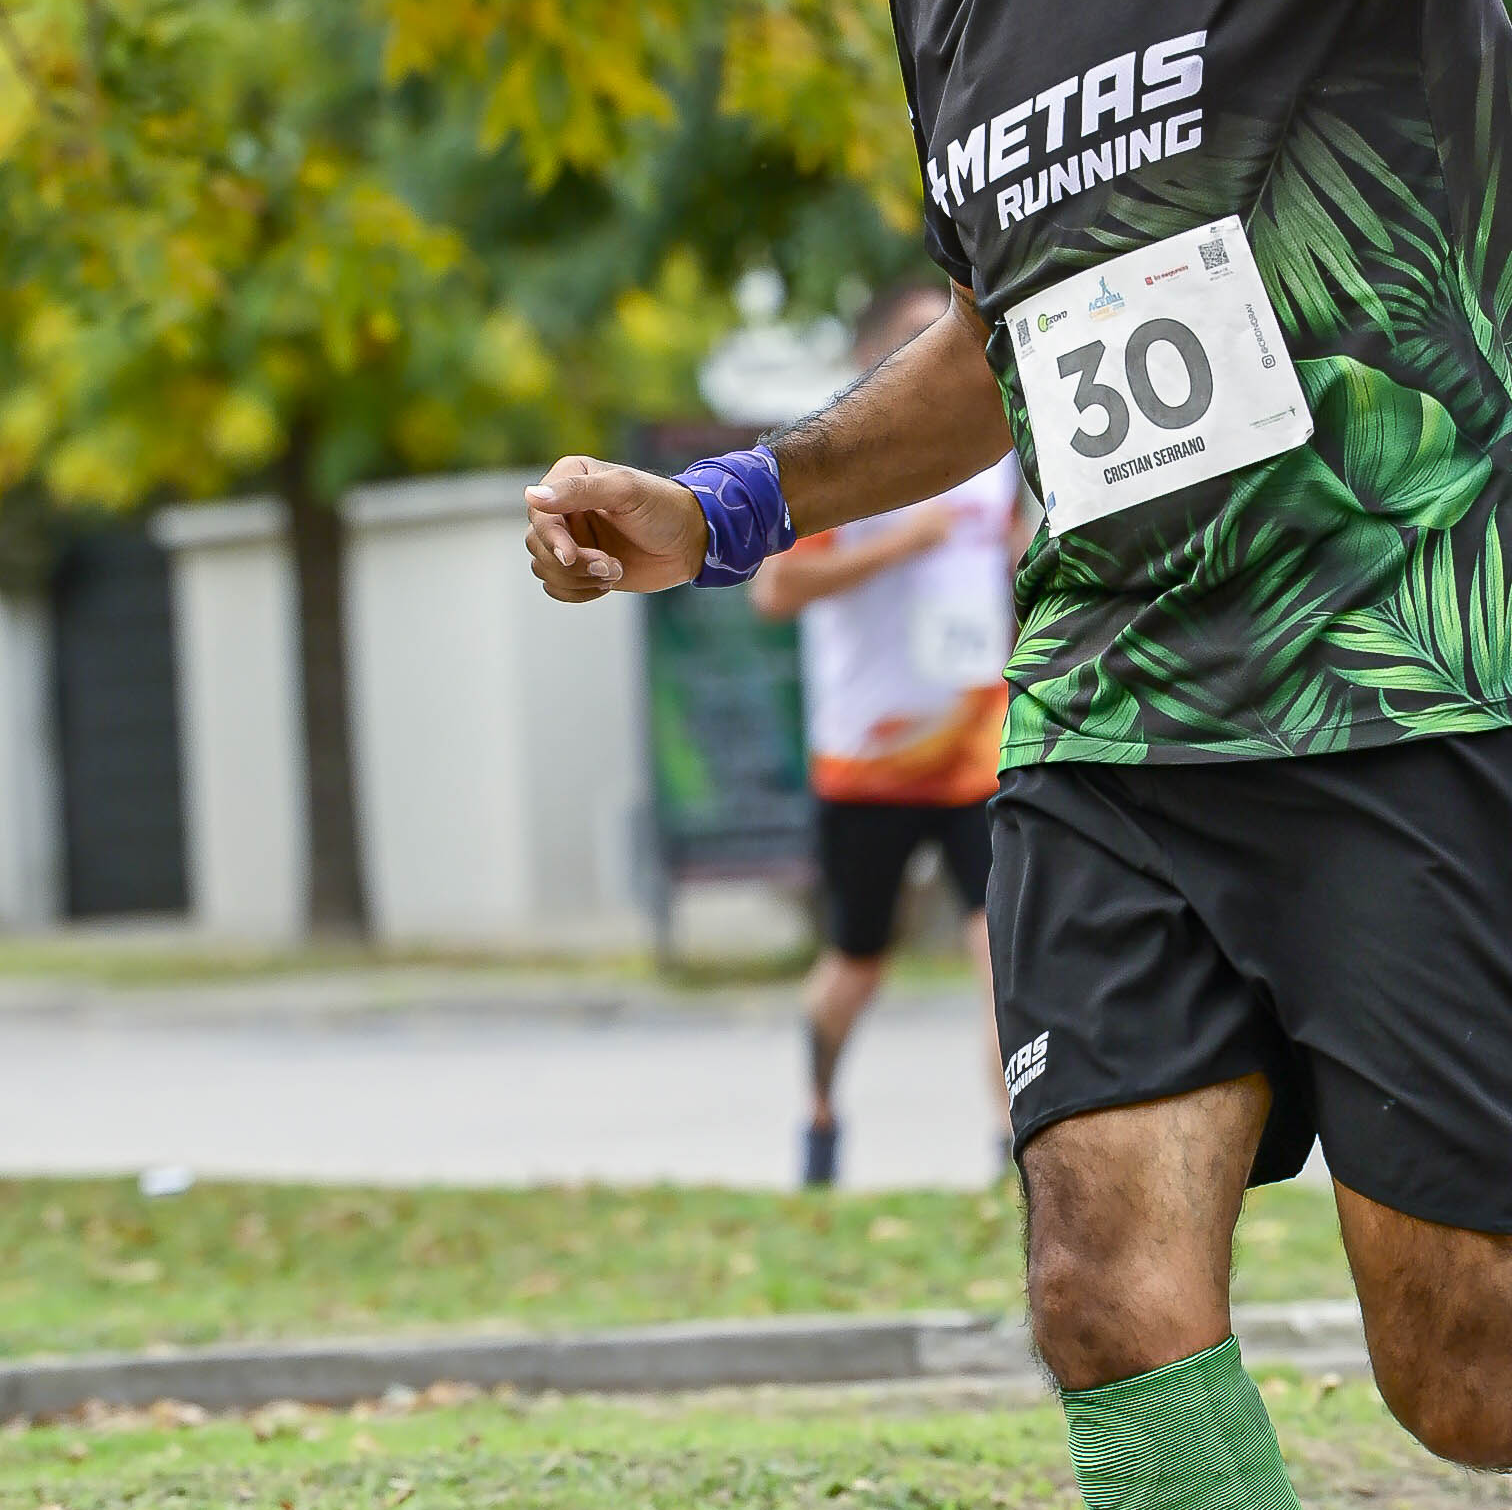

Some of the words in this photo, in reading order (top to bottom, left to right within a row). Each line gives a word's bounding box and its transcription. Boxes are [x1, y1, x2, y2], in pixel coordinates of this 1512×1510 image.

[997, 108, 1203, 231] RUNNING
[1056, 318, 1214, 459] 30
[1103, 454, 1154, 485] CRISTIAN
[1152, 435, 1206, 467] SERRANO
[1004, 1030, 1050, 1091] ETAS
